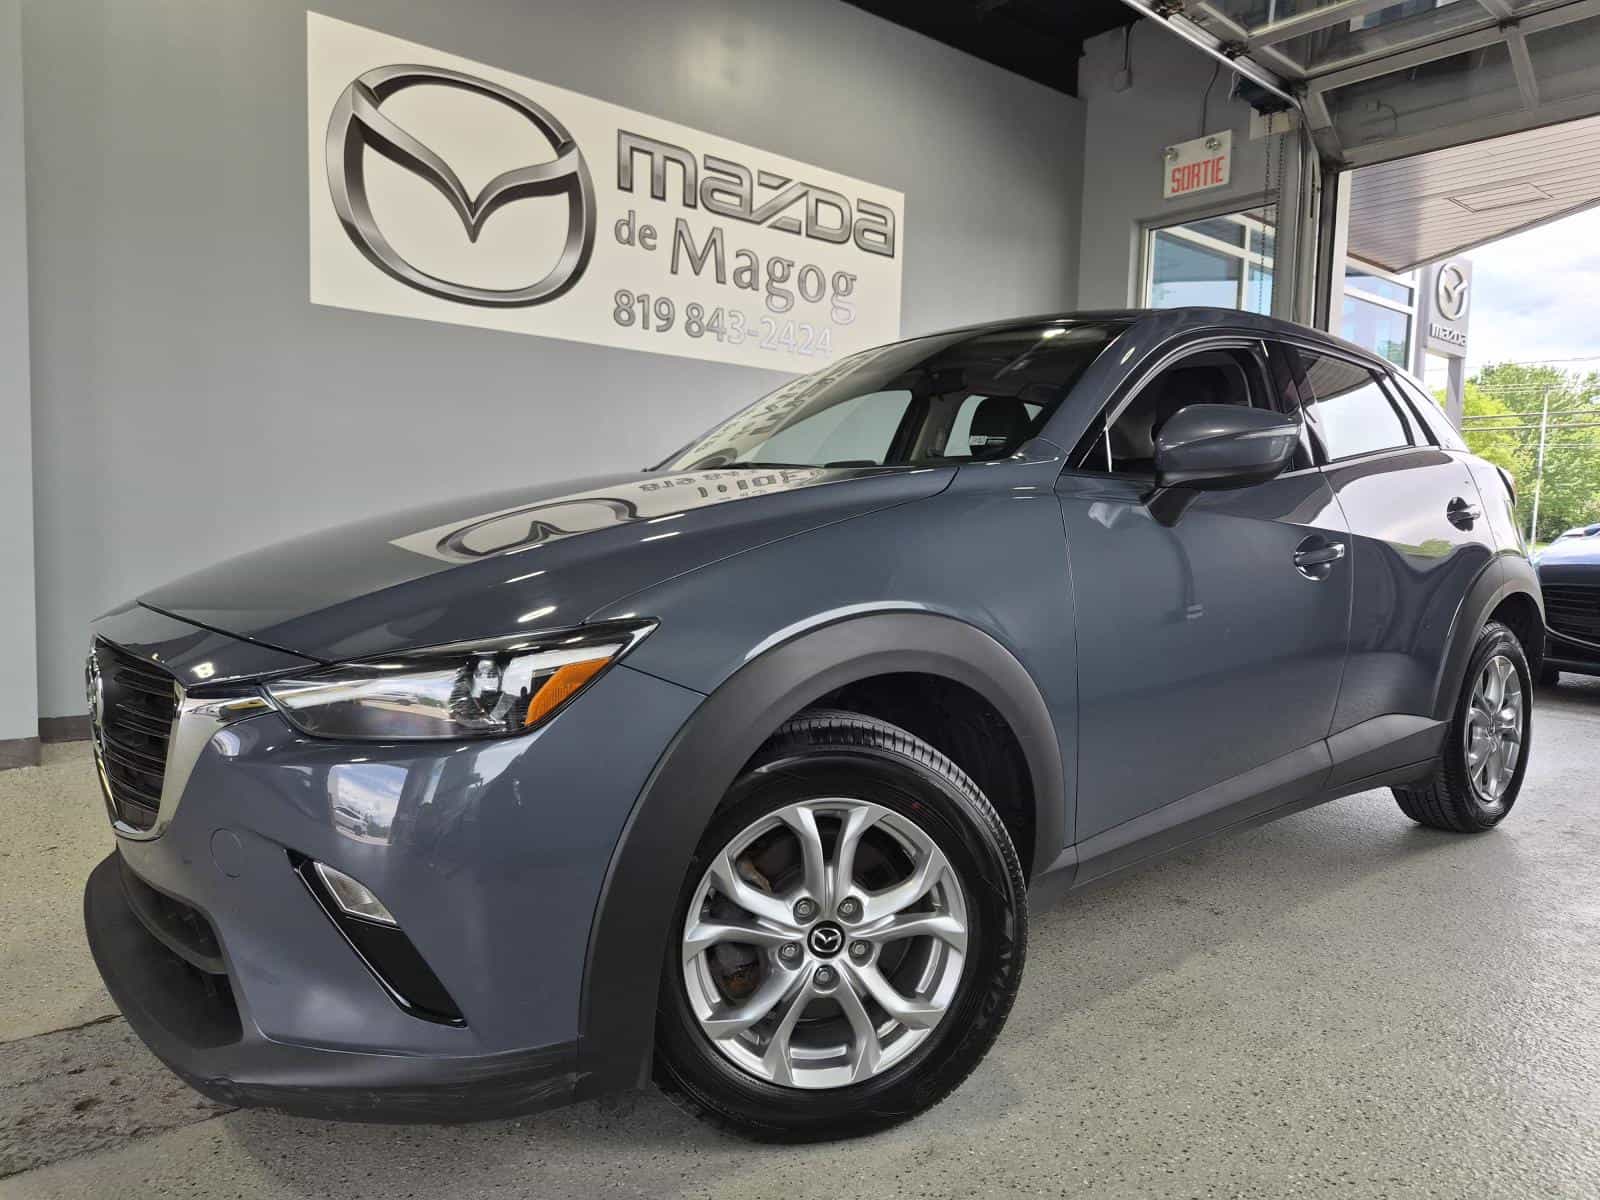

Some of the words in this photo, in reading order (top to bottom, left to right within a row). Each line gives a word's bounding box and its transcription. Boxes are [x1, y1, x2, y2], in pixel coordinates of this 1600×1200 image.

[1171, 156, 1225, 193] SORTIE
[614, 210, 658, 251] de
[670, 217, 857, 325] Magog
[613, 289, 675, 333] 819
[685, 302, 832, 357] 843-2424
